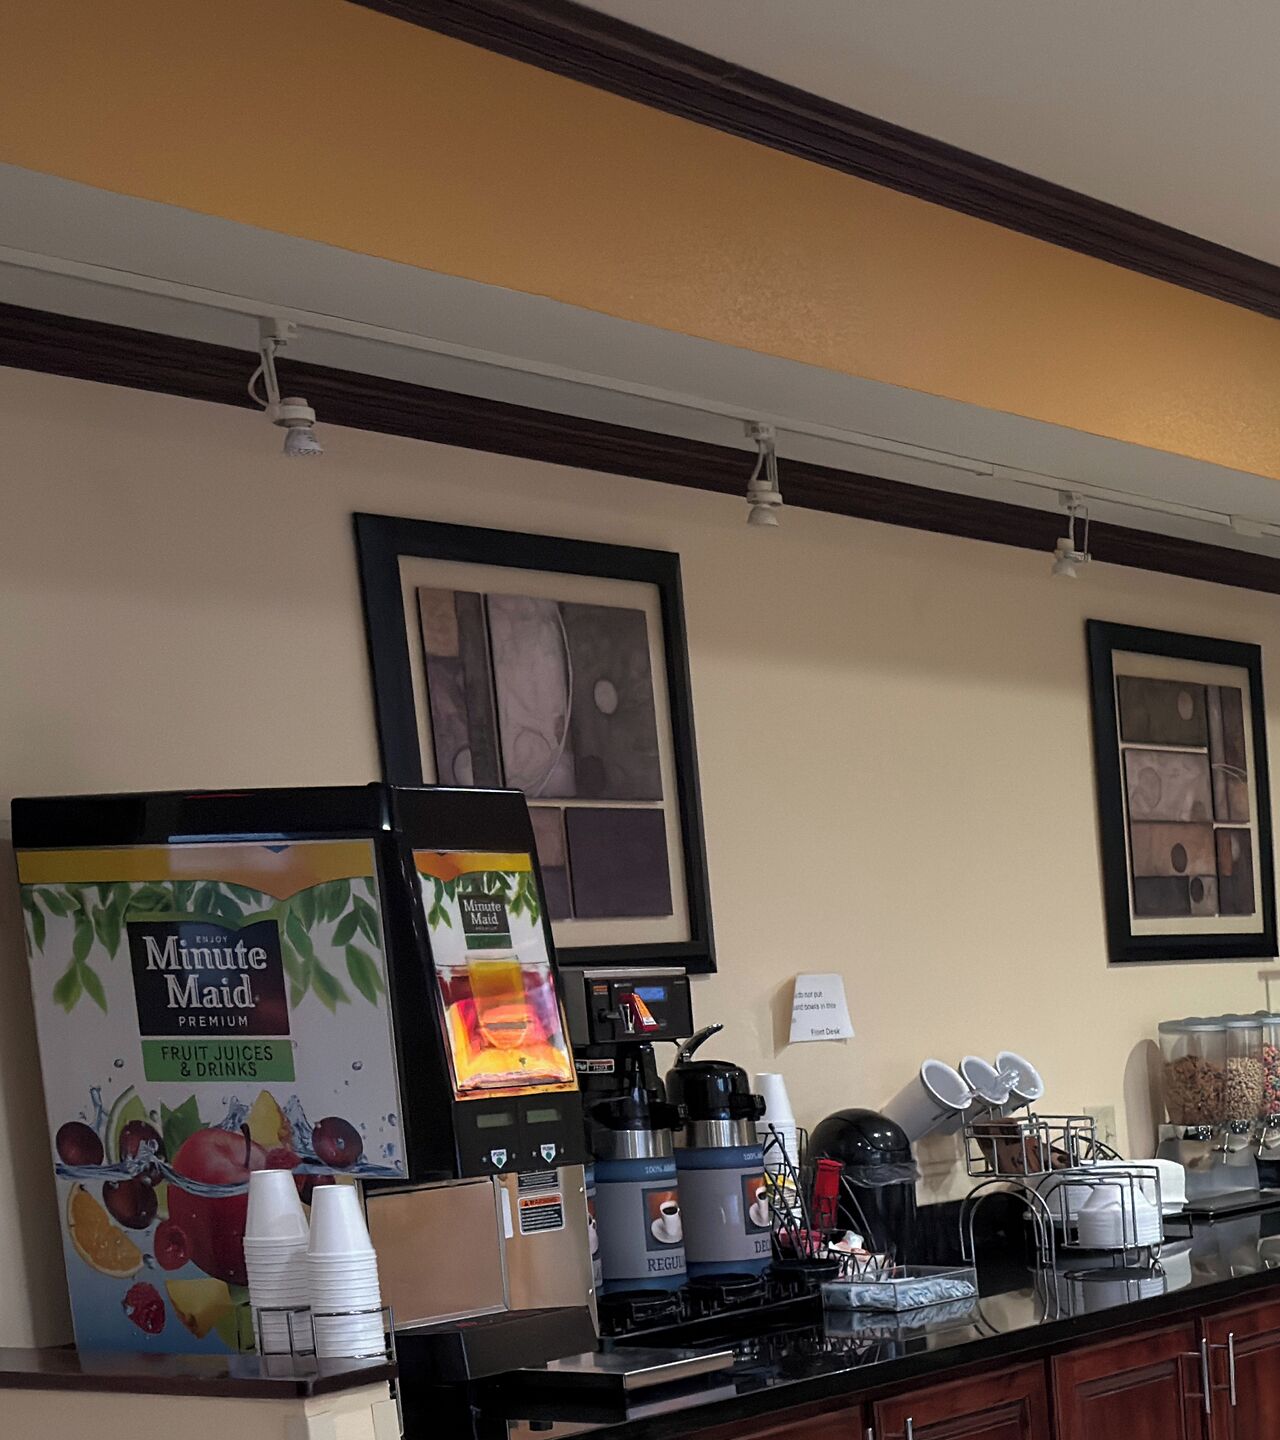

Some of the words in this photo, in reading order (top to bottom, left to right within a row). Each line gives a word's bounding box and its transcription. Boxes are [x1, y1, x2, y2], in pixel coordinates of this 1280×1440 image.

[463, 899, 502, 912] Minute
[471, 912, 499, 925] Maid
[196, 935, 228, 944] ENJOY
[142, 935, 268, 970] Minute
[163, 974, 256, 1009] Maid
[178, 1015, 249, 1027] PREMIUM
[161, 1046, 208, 1061] FRUIT
[213, 1045, 274, 1061] JUICES
[180, 1062, 191, 1077] &
[196, 1061, 258, 1077] DRINKS
